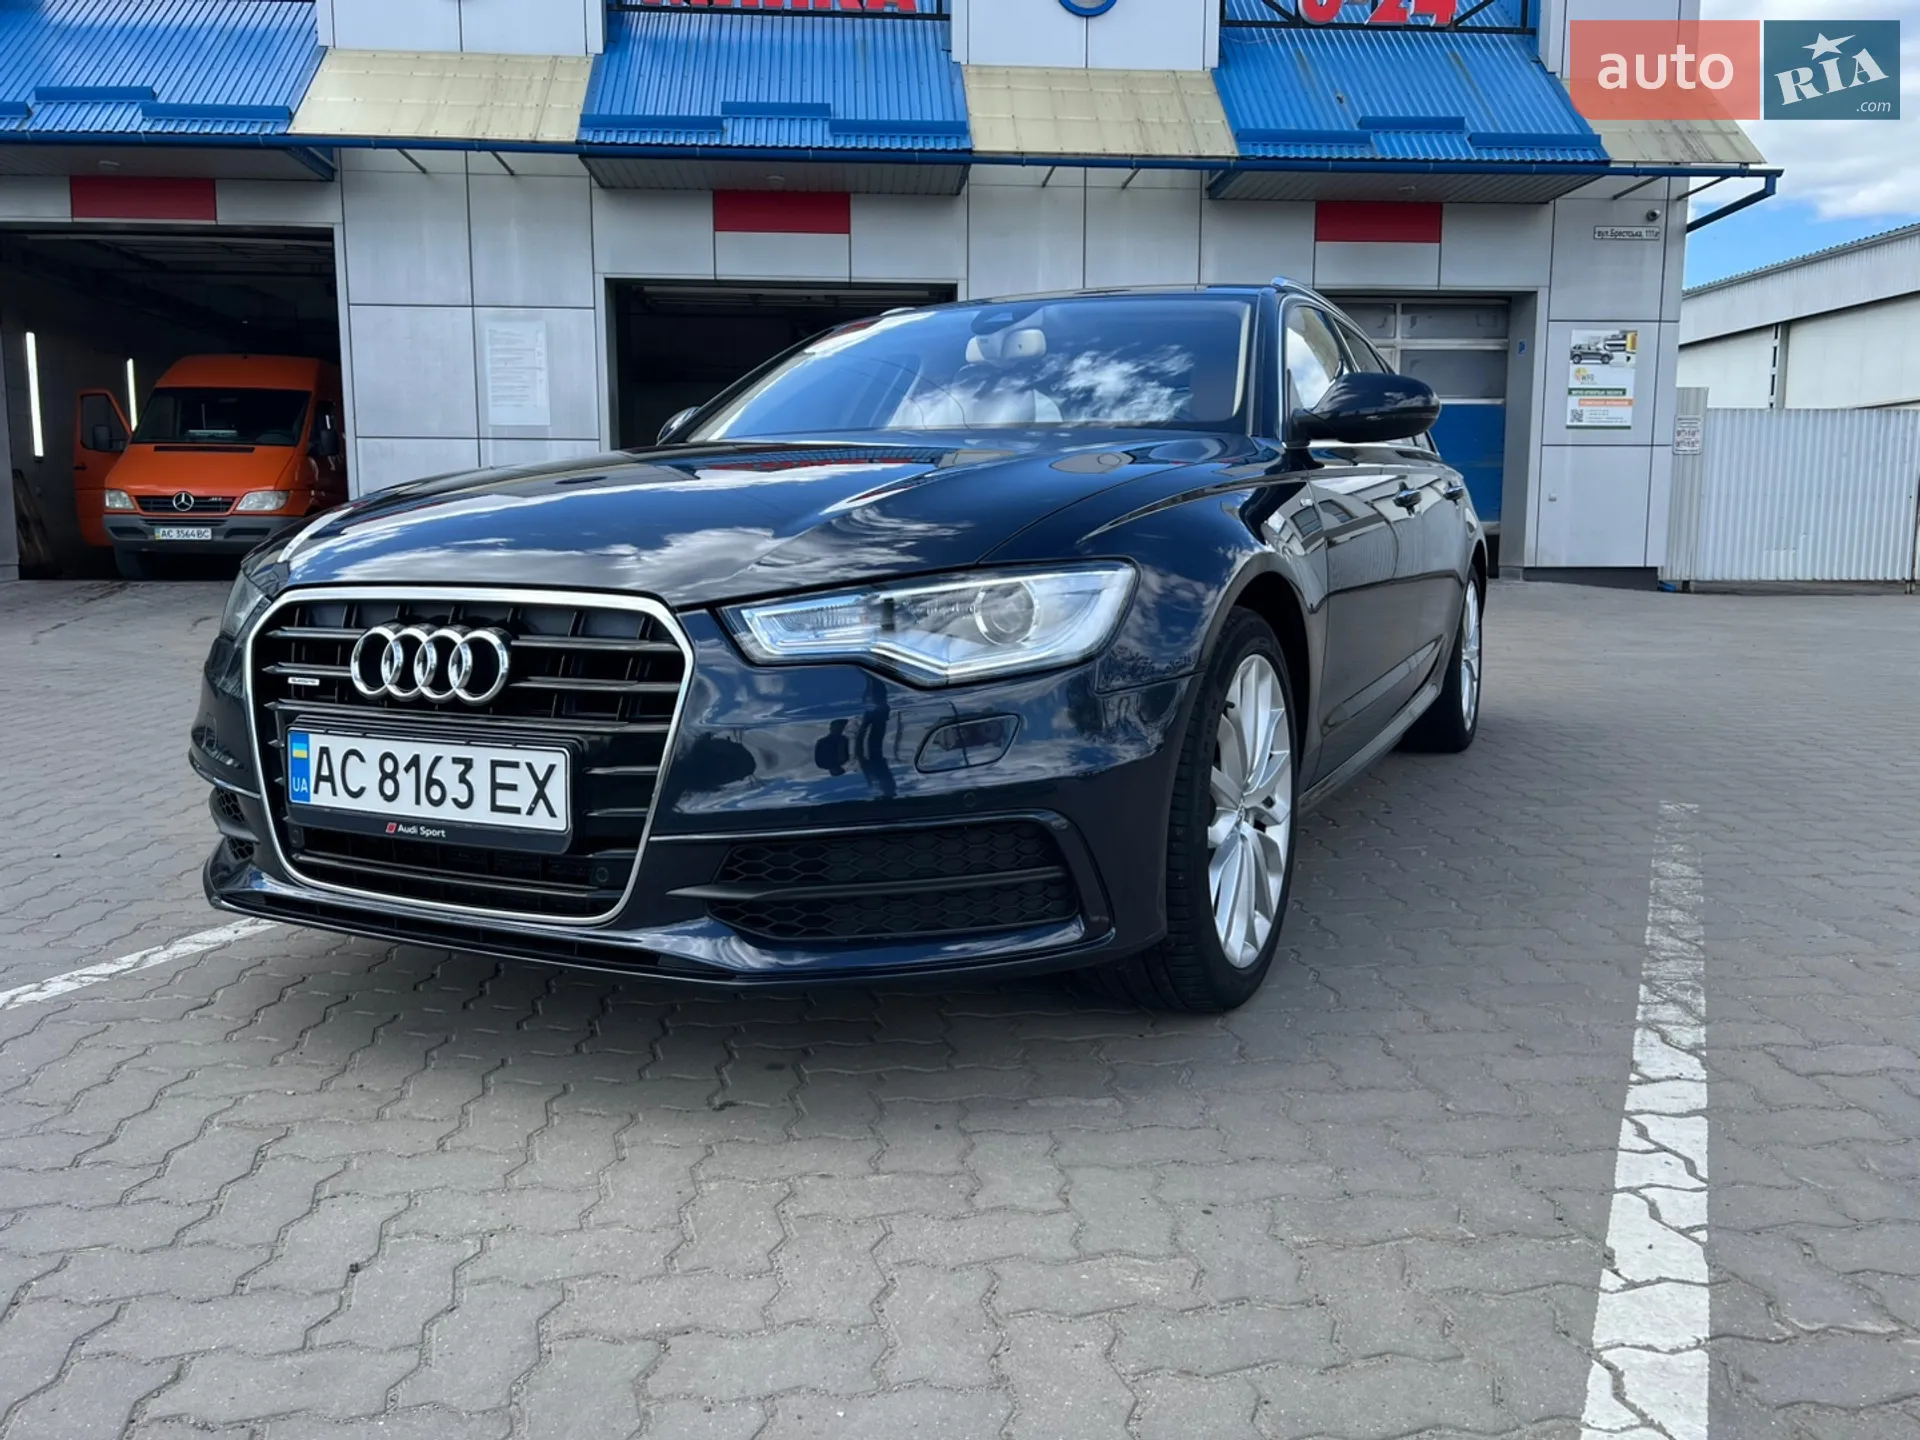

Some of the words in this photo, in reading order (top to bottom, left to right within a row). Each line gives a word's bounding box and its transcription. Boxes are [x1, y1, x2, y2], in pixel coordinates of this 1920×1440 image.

[161, 529, 173, 538] AC
[176, 529, 196, 539] 3564
[197, 529, 210, 538] BC
[291, 778, 309, 794] UA
[312, 745, 367, 799] AC
[378, 751, 475, 810] 8163
[489, 758, 558, 819] EX
[397, 823, 418, 835] Audi
[419, 825, 446, 838] Sport
